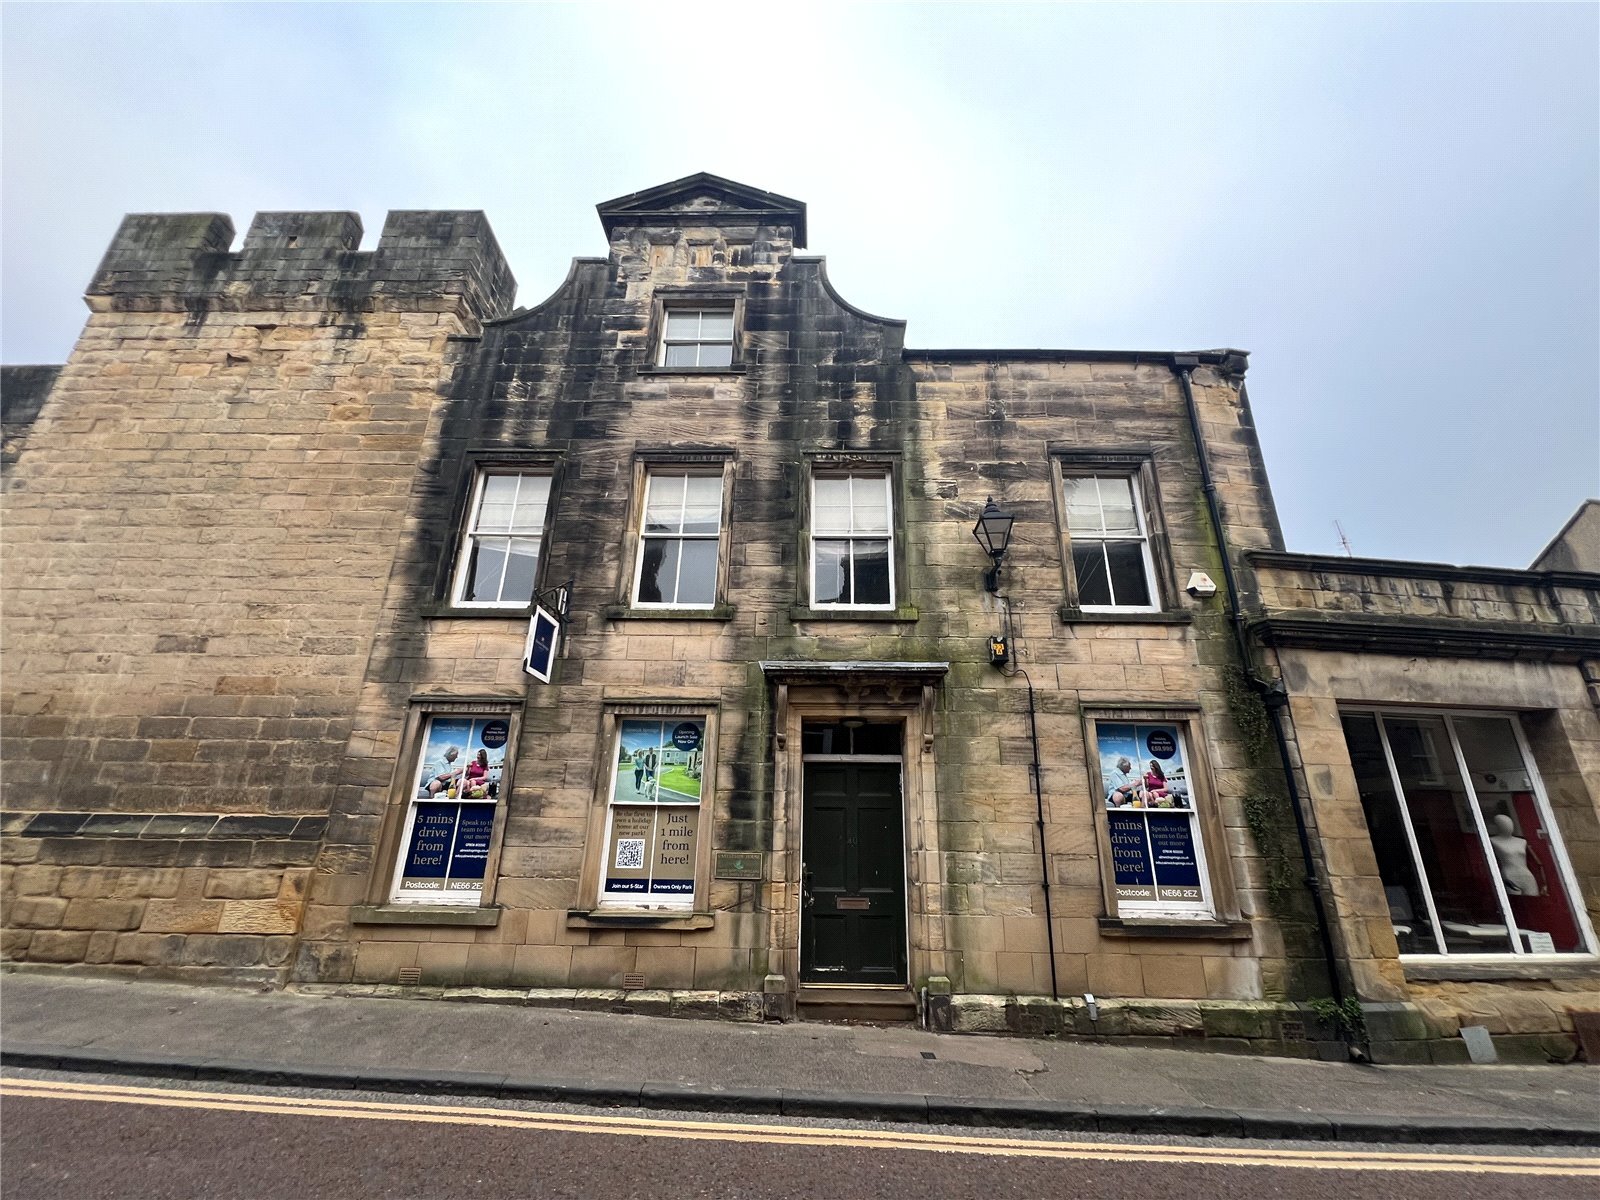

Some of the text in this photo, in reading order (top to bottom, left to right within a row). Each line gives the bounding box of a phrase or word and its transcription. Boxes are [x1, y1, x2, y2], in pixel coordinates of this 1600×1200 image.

[417, 814, 454, 824] 5 mins
[667, 813, 688, 825] Just
[1114, 819, 1142, 830] mins
[418, 826, 448, 837] drive
[669, 826, 693, 837] mile
[1111, 833, 1140, 844] drive
[416, 840, 444, 851] from
[662, 839, 689, 850] from
[1114, 846, 1142, 858] from
[413, 854, 442, 865] here!
[660, 853, 689, 864] here!
[1115, 860, 1145, 872] here!
